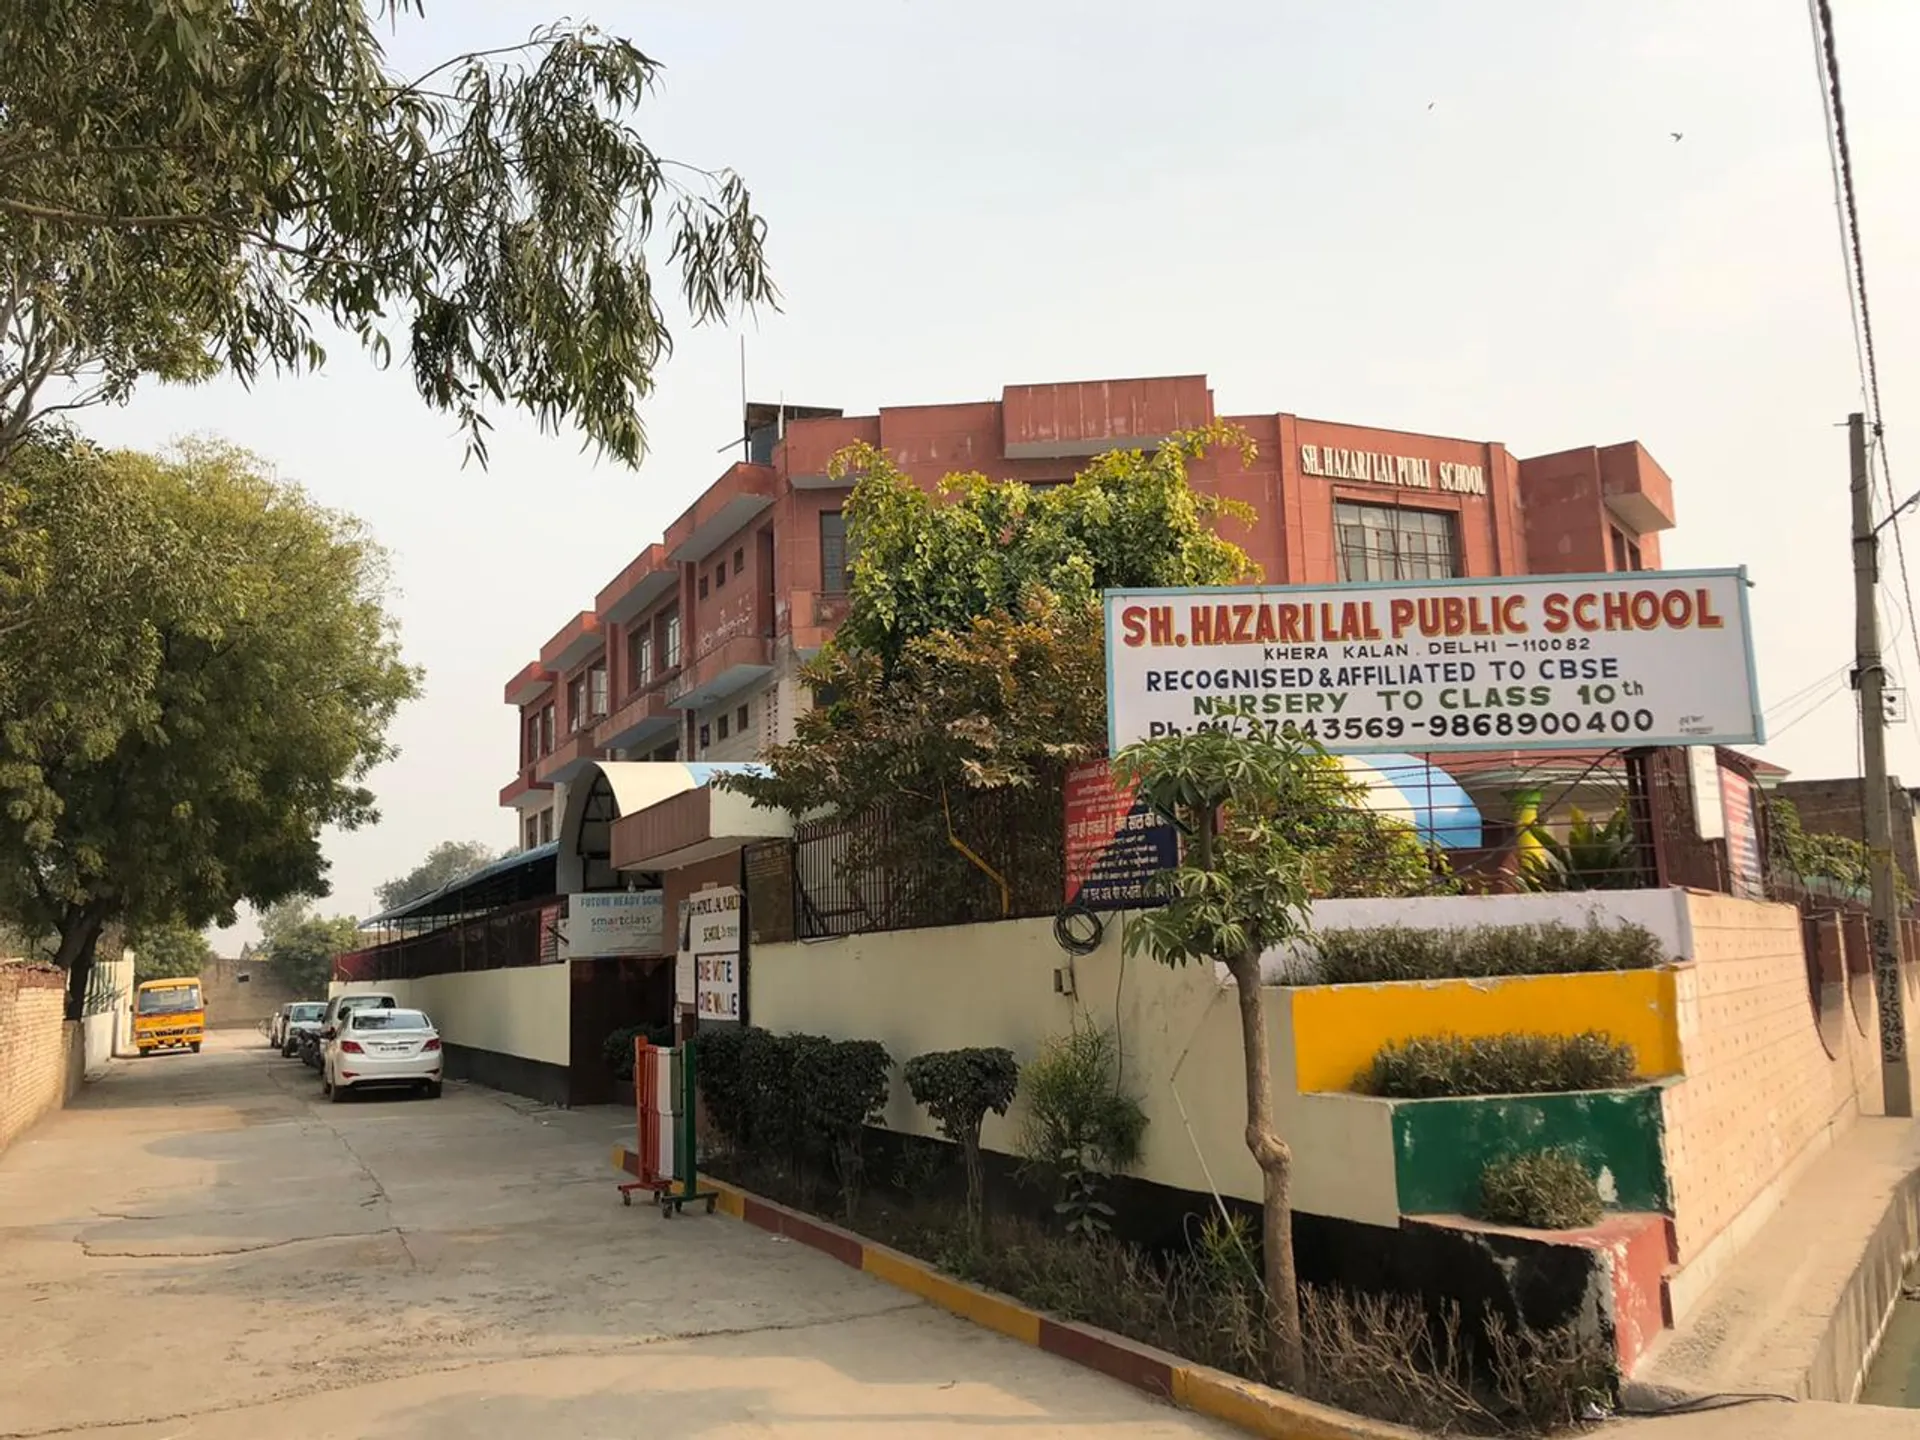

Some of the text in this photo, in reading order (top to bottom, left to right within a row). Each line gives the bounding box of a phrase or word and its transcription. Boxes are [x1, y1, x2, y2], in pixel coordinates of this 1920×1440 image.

[1323, 447, 1371, 481] HAZARI
[1373, 453, 1395, 484] LAL
[1440, 462, 1486, 495] SCHOOL
[1190, 602, 1316, 647] HAZARI
[1320, 601, 1382, 642] LAL
[1391, 594, 1529, 639] PUBLIC
[1543, 588, 1723, 634] SCHOOL
[1264, 646, 1329, 661] KHERA
[1489, 660, 1526, 681] TO
[1539, 658, 1619, 680] CBSE
[1193, 692, 1349, 716] NURSERY
[1377, 689, 1424, 712] TO
[1439, 686, 1552, 709] CLASS
